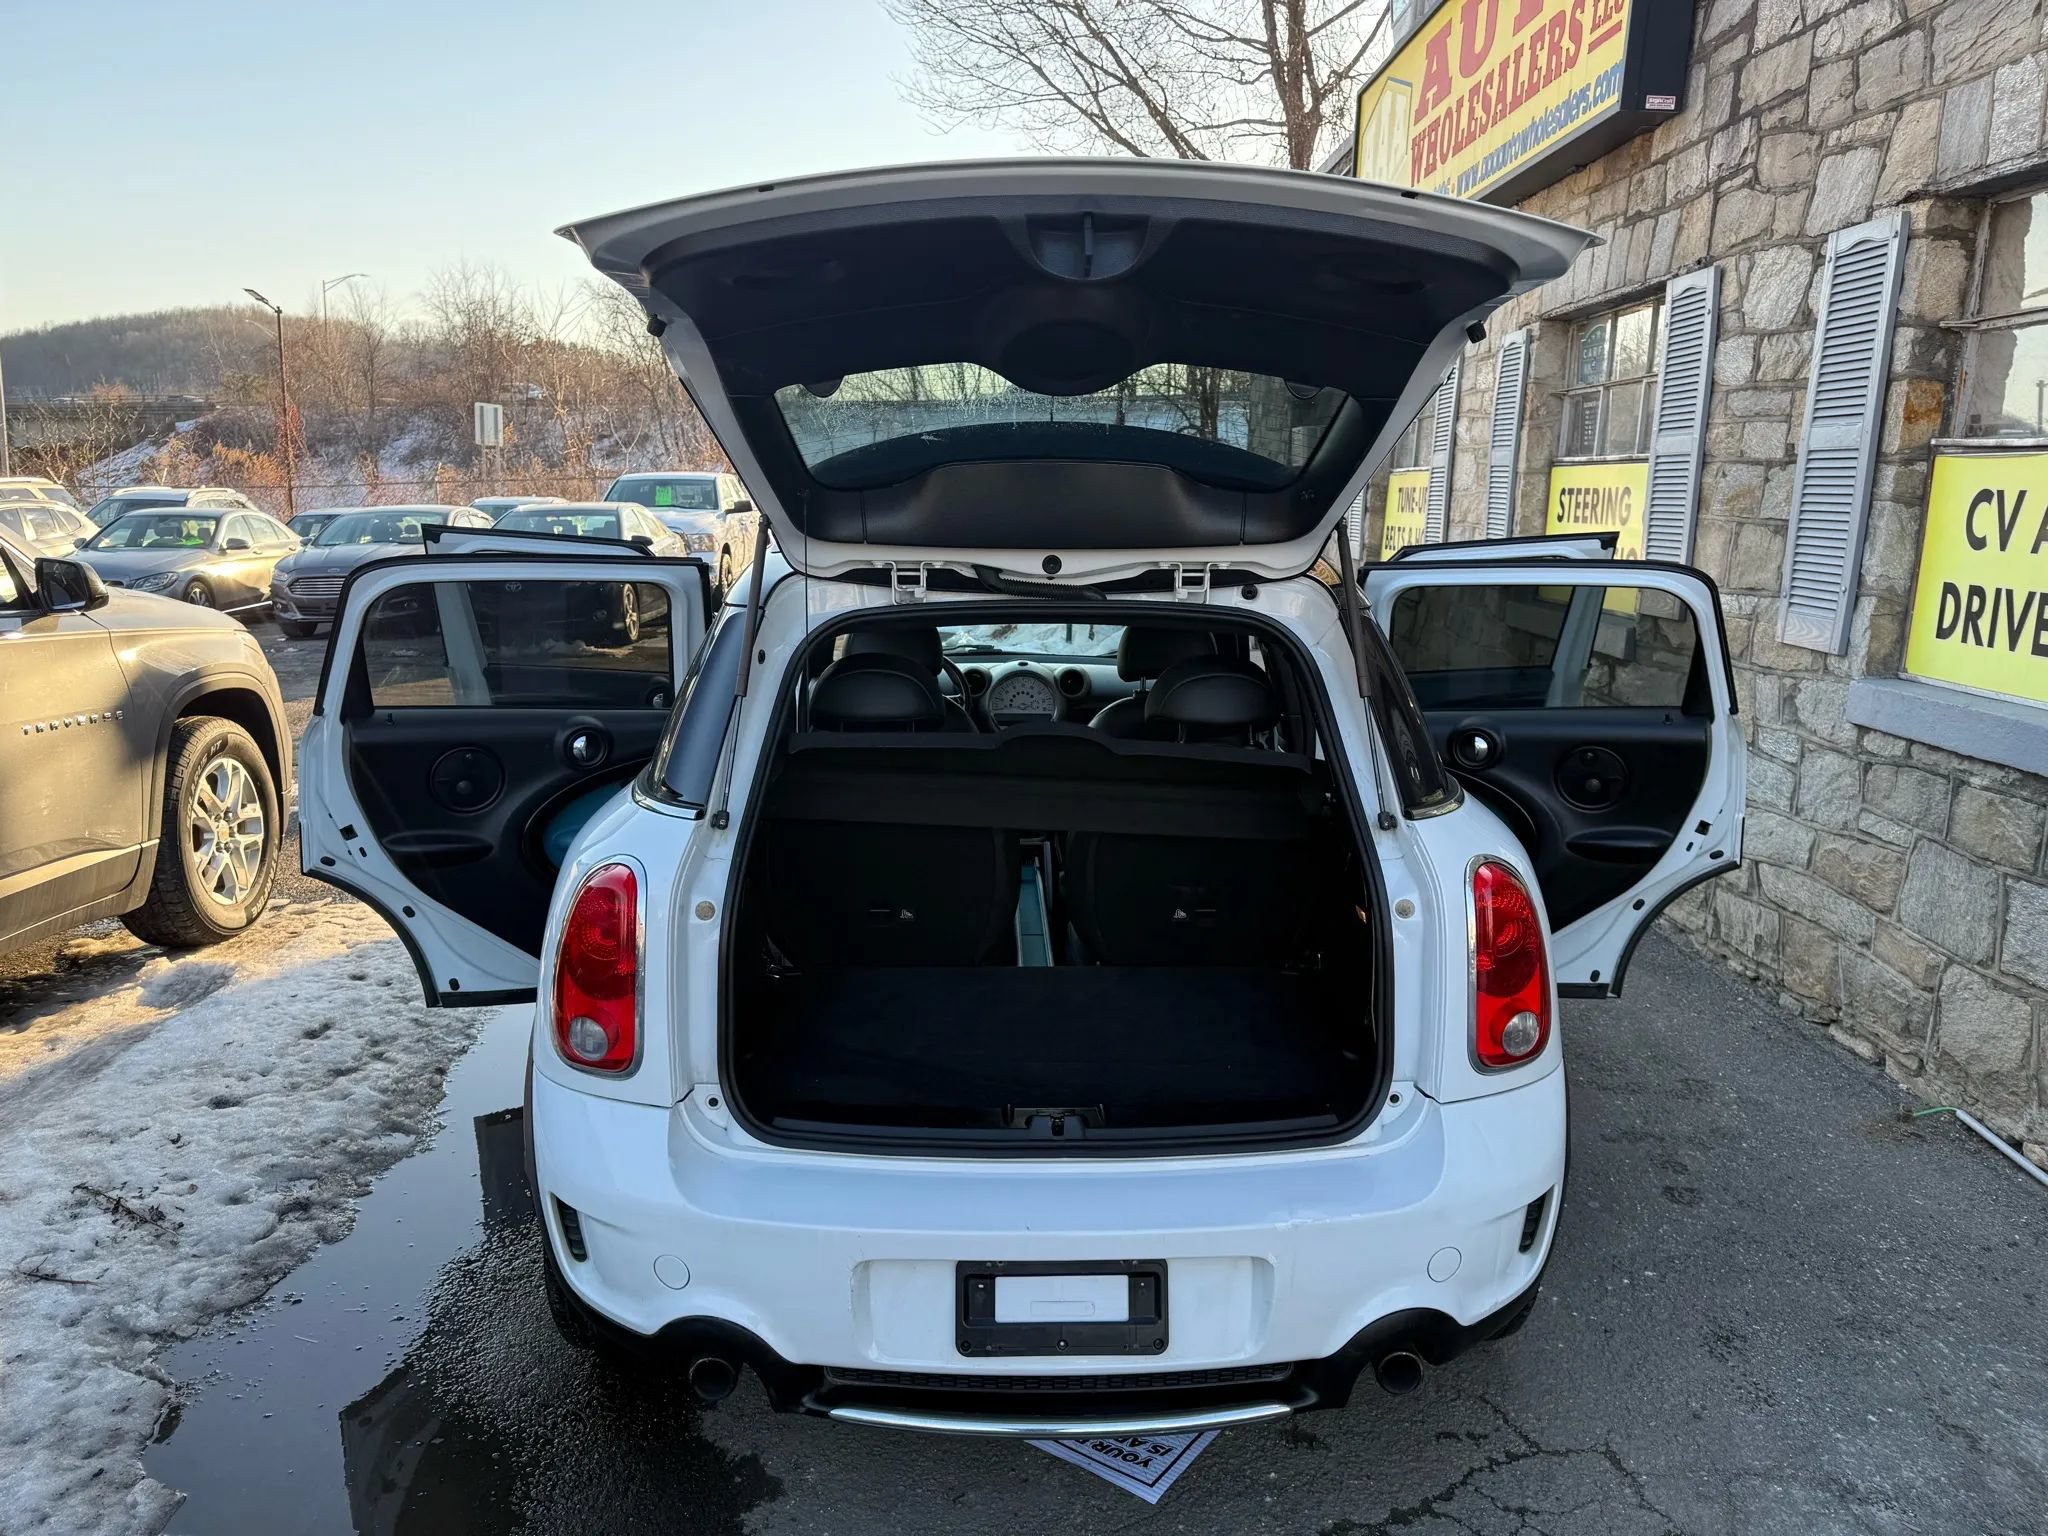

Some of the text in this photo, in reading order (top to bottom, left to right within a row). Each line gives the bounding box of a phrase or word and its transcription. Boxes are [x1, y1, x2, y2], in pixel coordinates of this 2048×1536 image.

[1411, 0, 1584, 188] WHOLESALERS
[1557, 486, 1632, 527] STEERING
[1965, 488, 2028, 552] CV
[21, 710, 125, 736] TRAVERSE
[1090, 1441, 1156, 1468] YOUR
